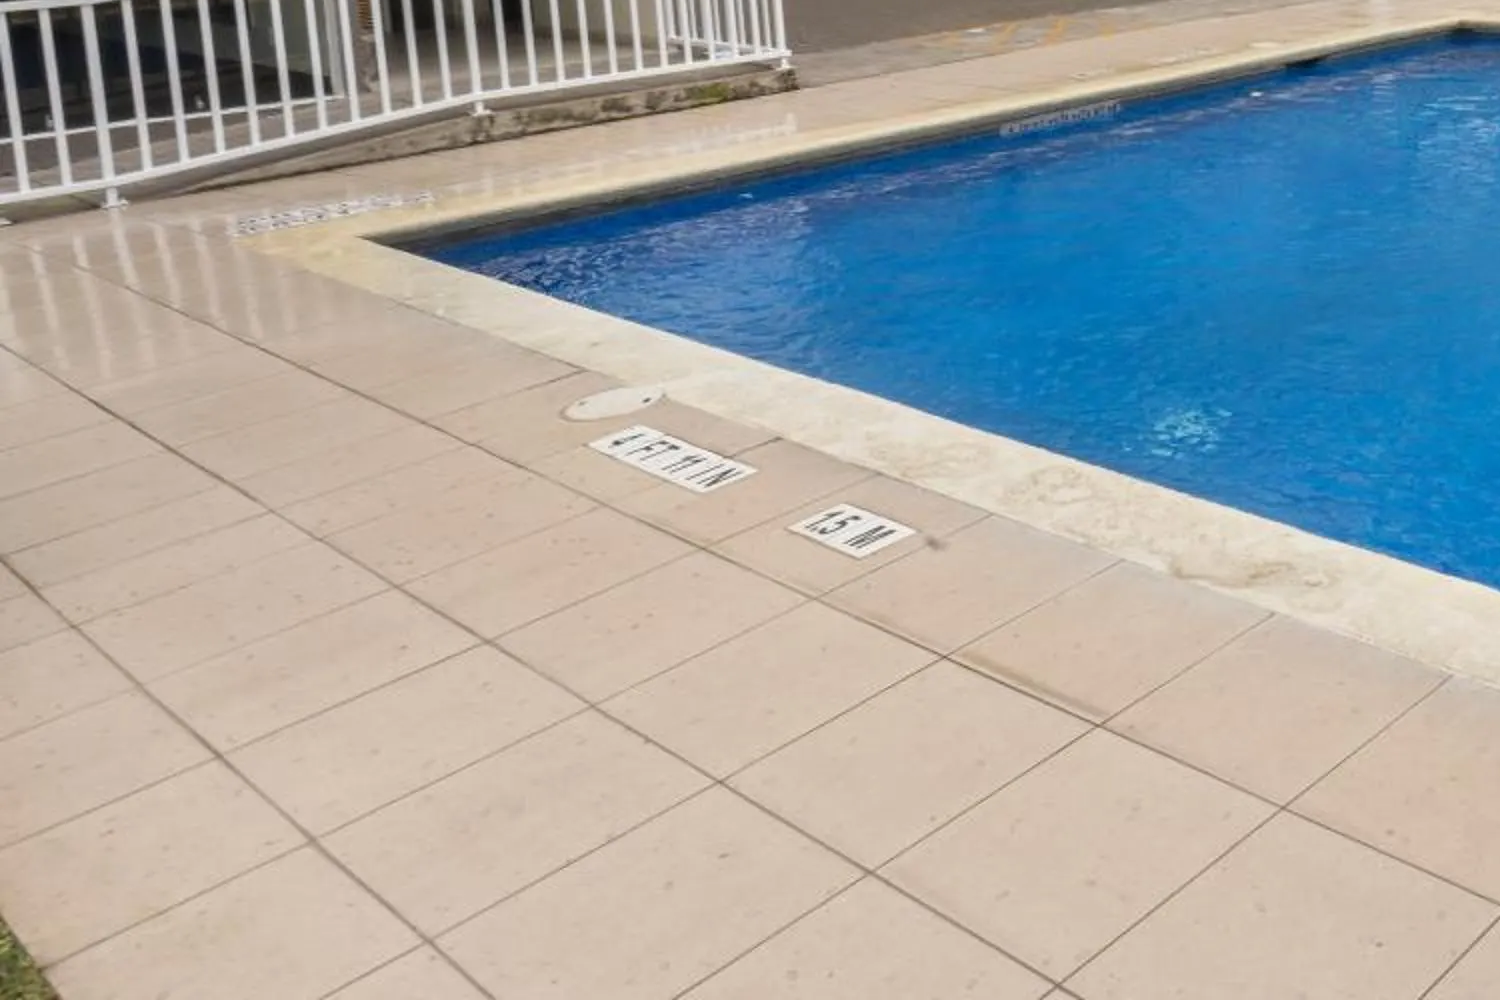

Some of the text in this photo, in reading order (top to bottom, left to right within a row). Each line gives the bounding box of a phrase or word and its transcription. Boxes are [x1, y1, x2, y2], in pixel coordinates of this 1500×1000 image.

[625, 440, 682, 461] FT
[661, 453, 708, 475] 11
[685, 463, 745, 488] IN
[843, 525, 897, 550] M
